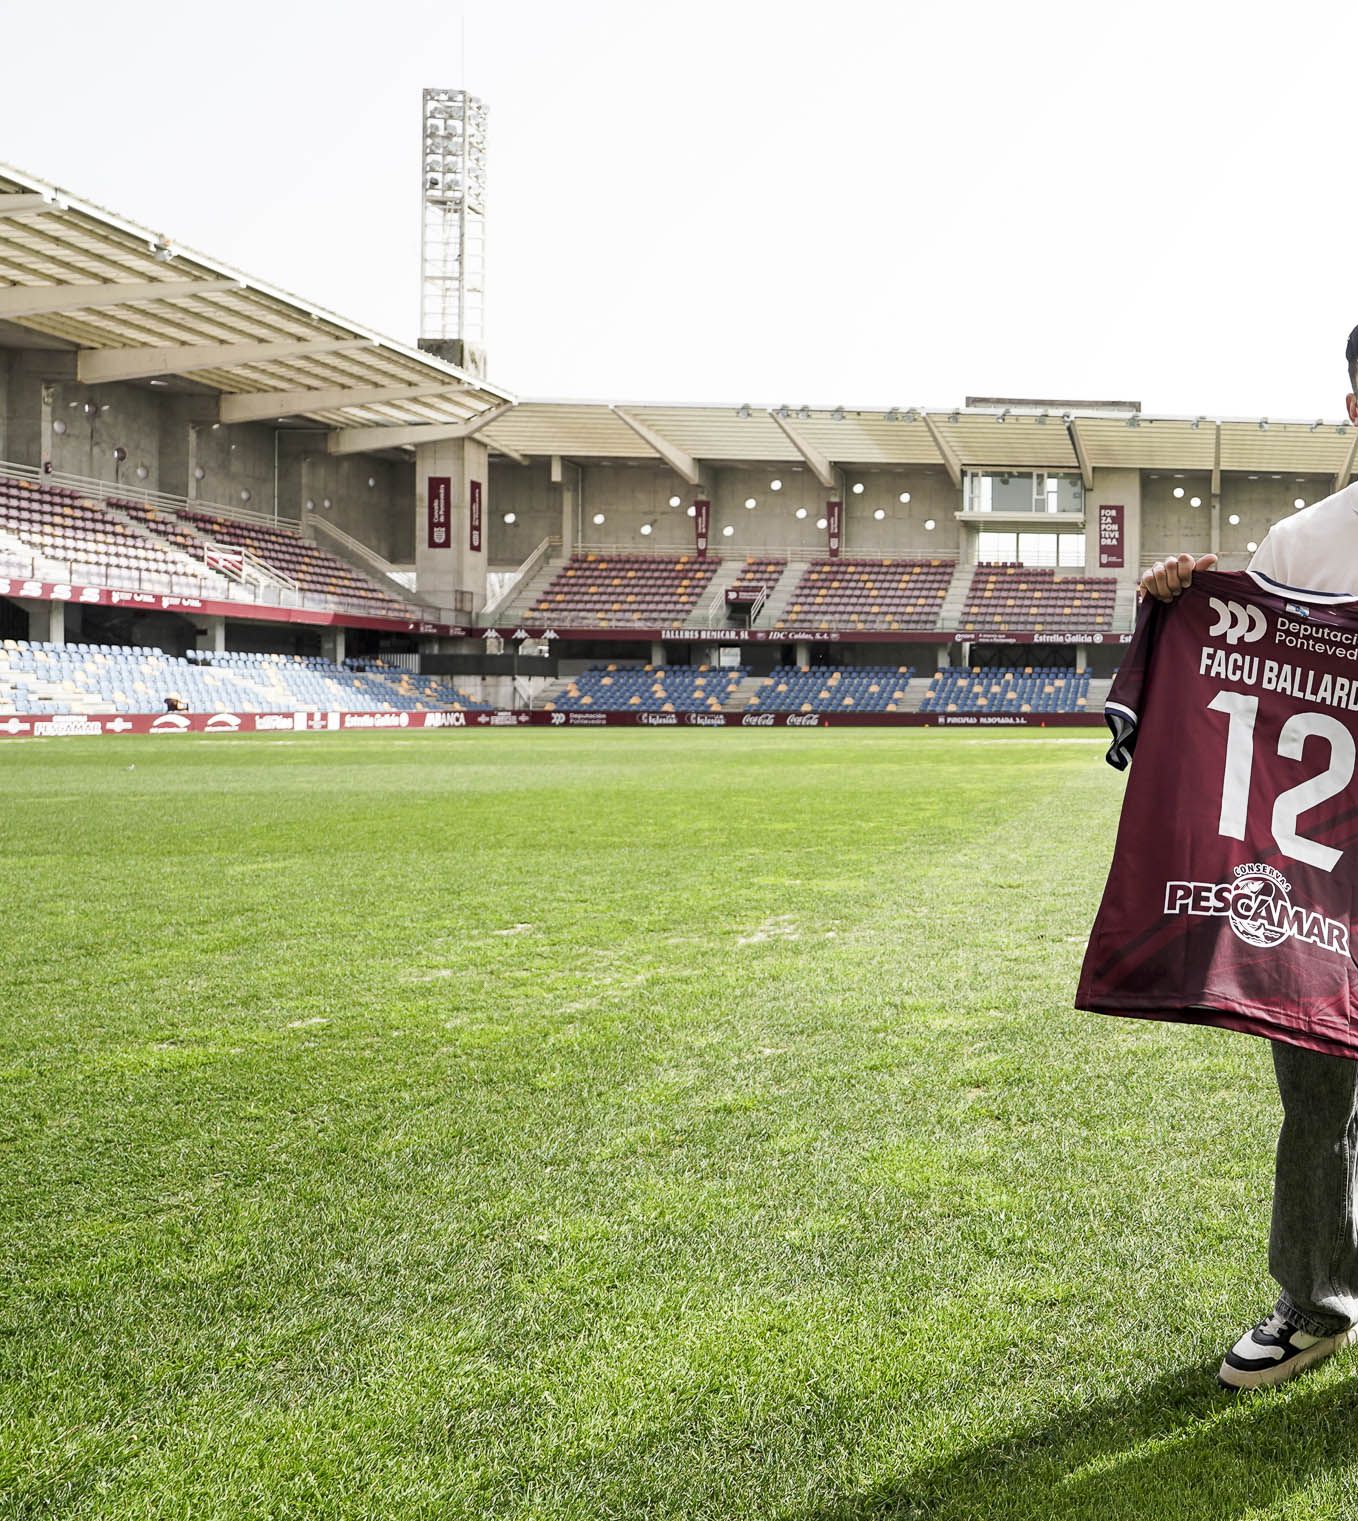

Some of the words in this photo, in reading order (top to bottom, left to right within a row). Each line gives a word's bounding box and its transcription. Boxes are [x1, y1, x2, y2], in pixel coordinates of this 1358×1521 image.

[1101, 509, 1117, 517] FOR
[1101, 538, 1118, 546] DRA
[661, 630, 699, 640] TALLERES
[768, 631, 787, 640] IDC
[1033, 633, 1064, 643] Estrella
[1064, 633, 1093, 644] Galicia
[1199, 646, 1259, 685] FACU
[423, 712, 467, 727] ABANCA
[1206, 690, 1357, 873] 12
[1234, 863, 1292, 893] CONSERVAS
[1164, 881, 1351, 958] PESCAMAR
